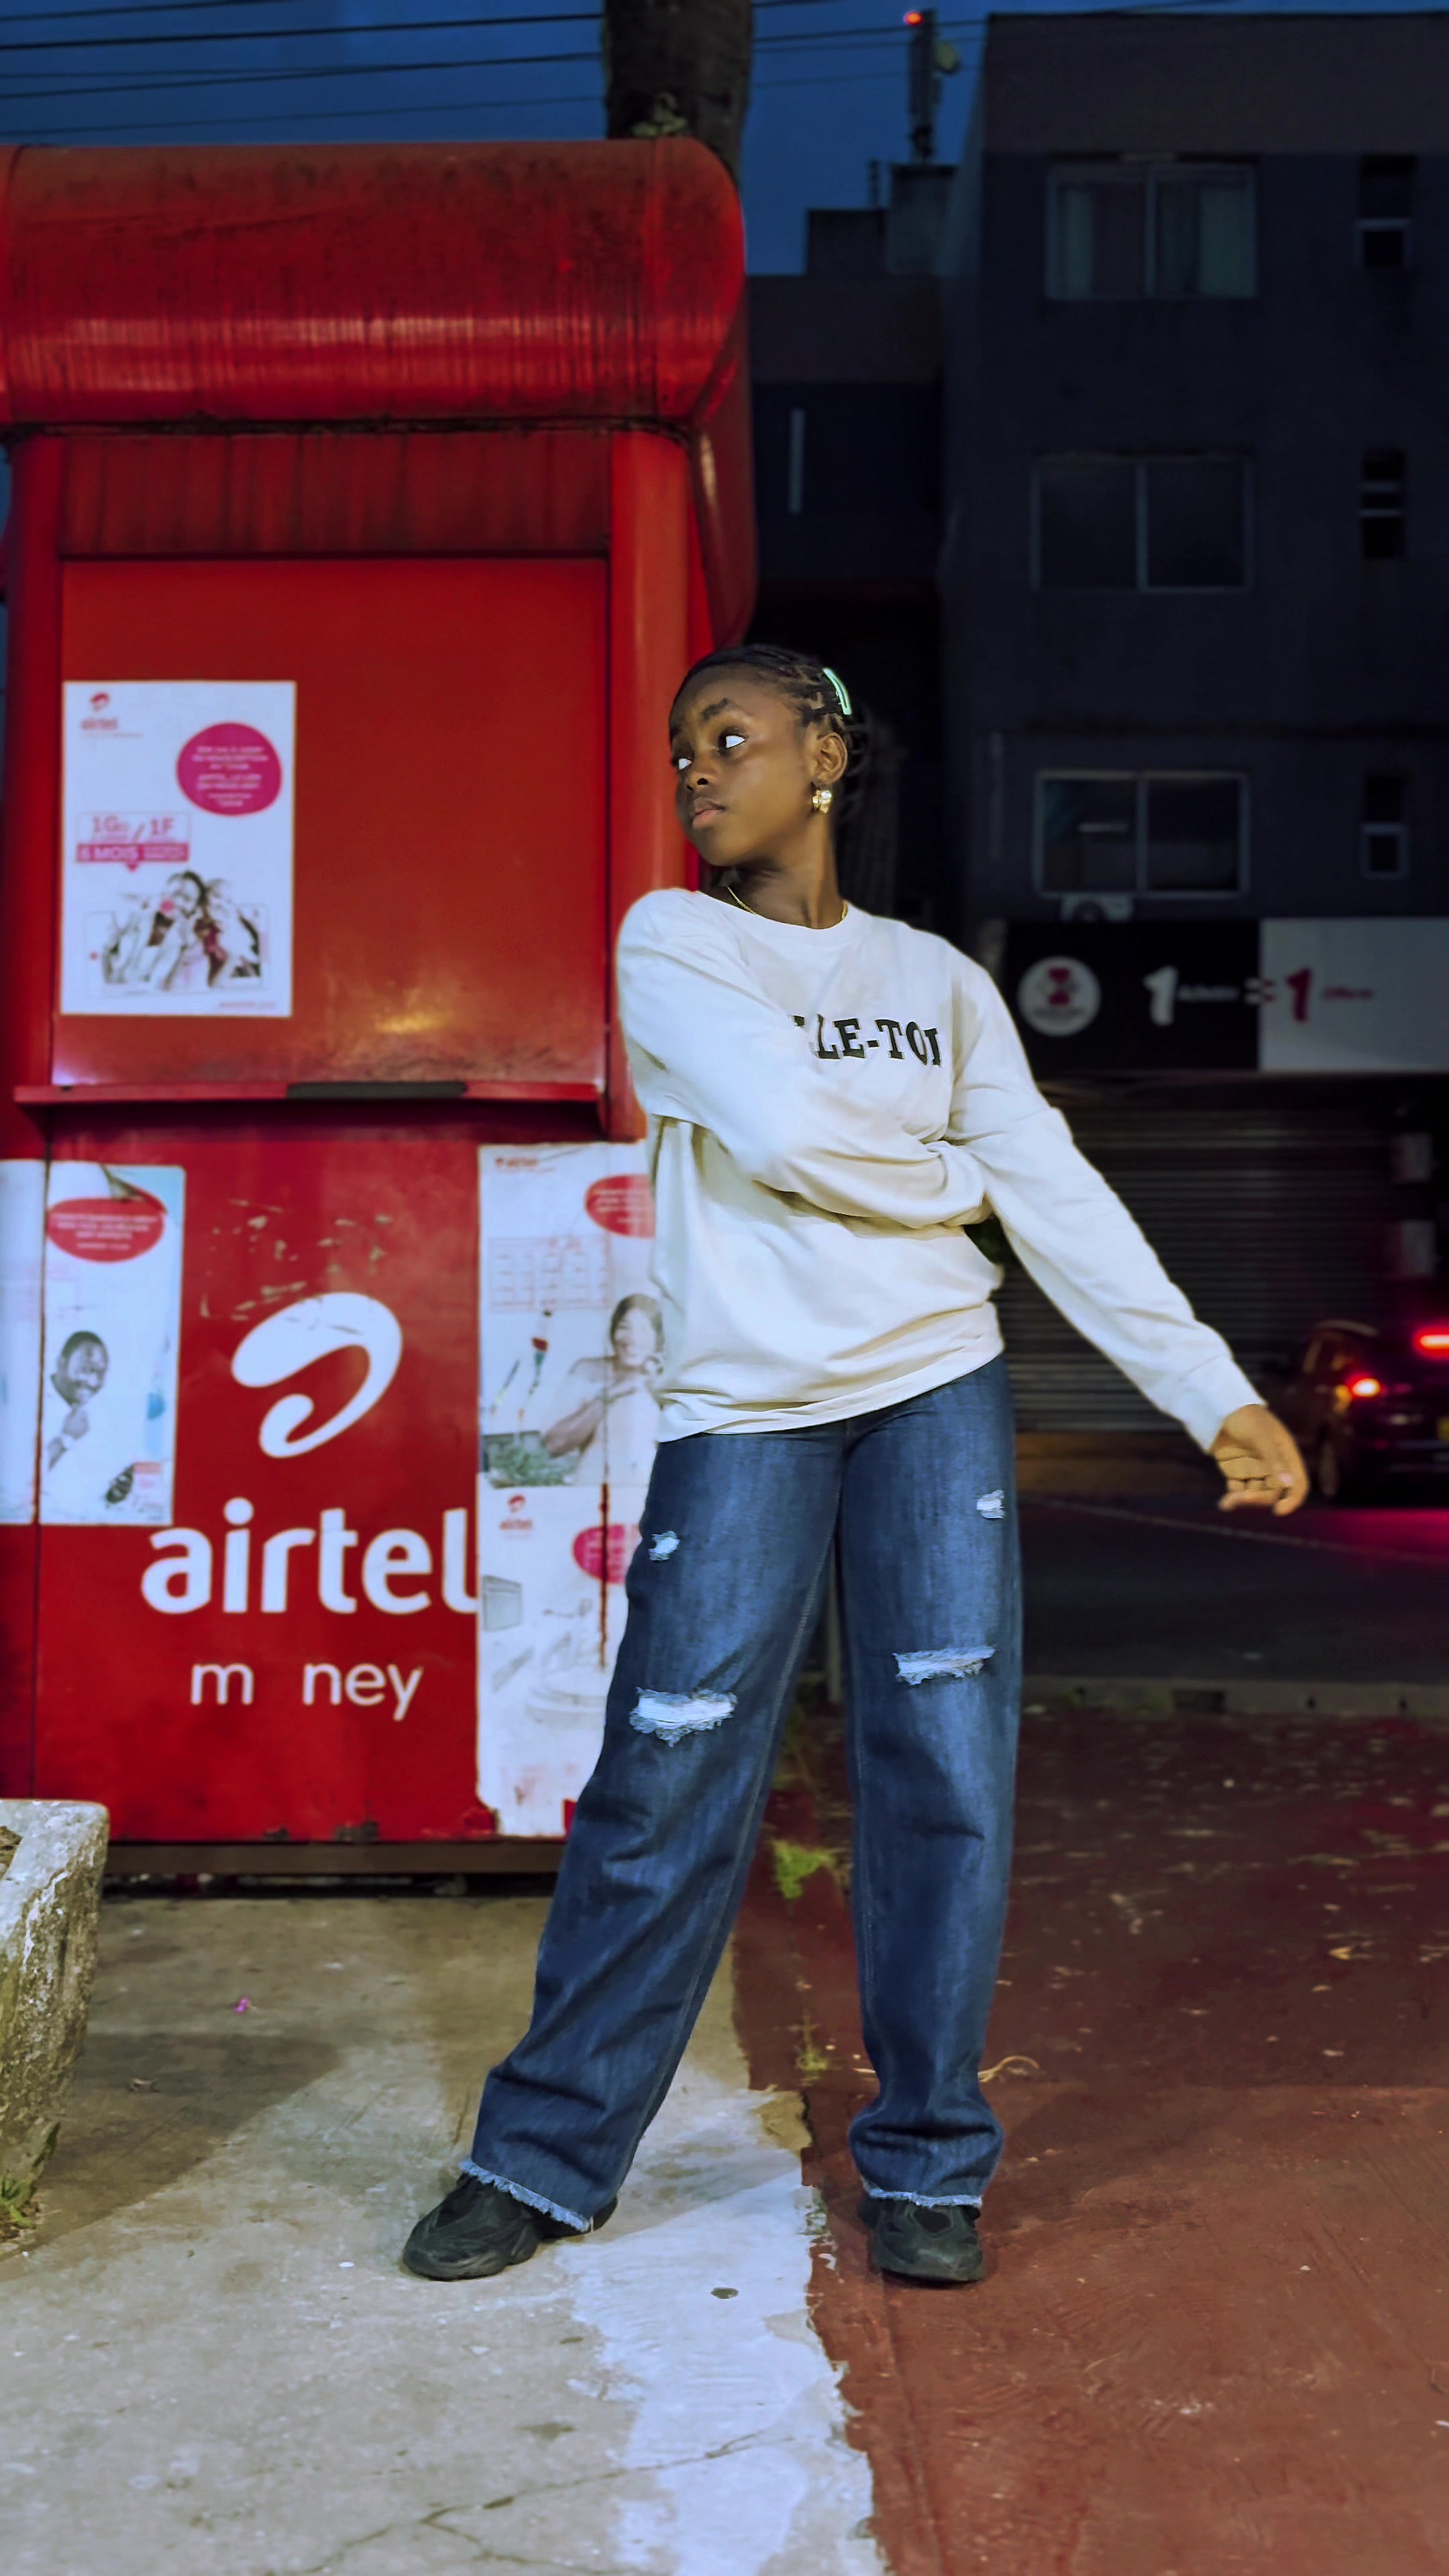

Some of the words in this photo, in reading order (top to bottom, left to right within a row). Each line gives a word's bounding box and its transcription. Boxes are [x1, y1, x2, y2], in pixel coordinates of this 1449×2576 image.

[1143, 965, 1177, 1026] 1
[1285, 966, 1313, 1024] 1
[794, 1013, 941, 1067] LE-TOI
[141, 1497, 478, 1614] airtel
